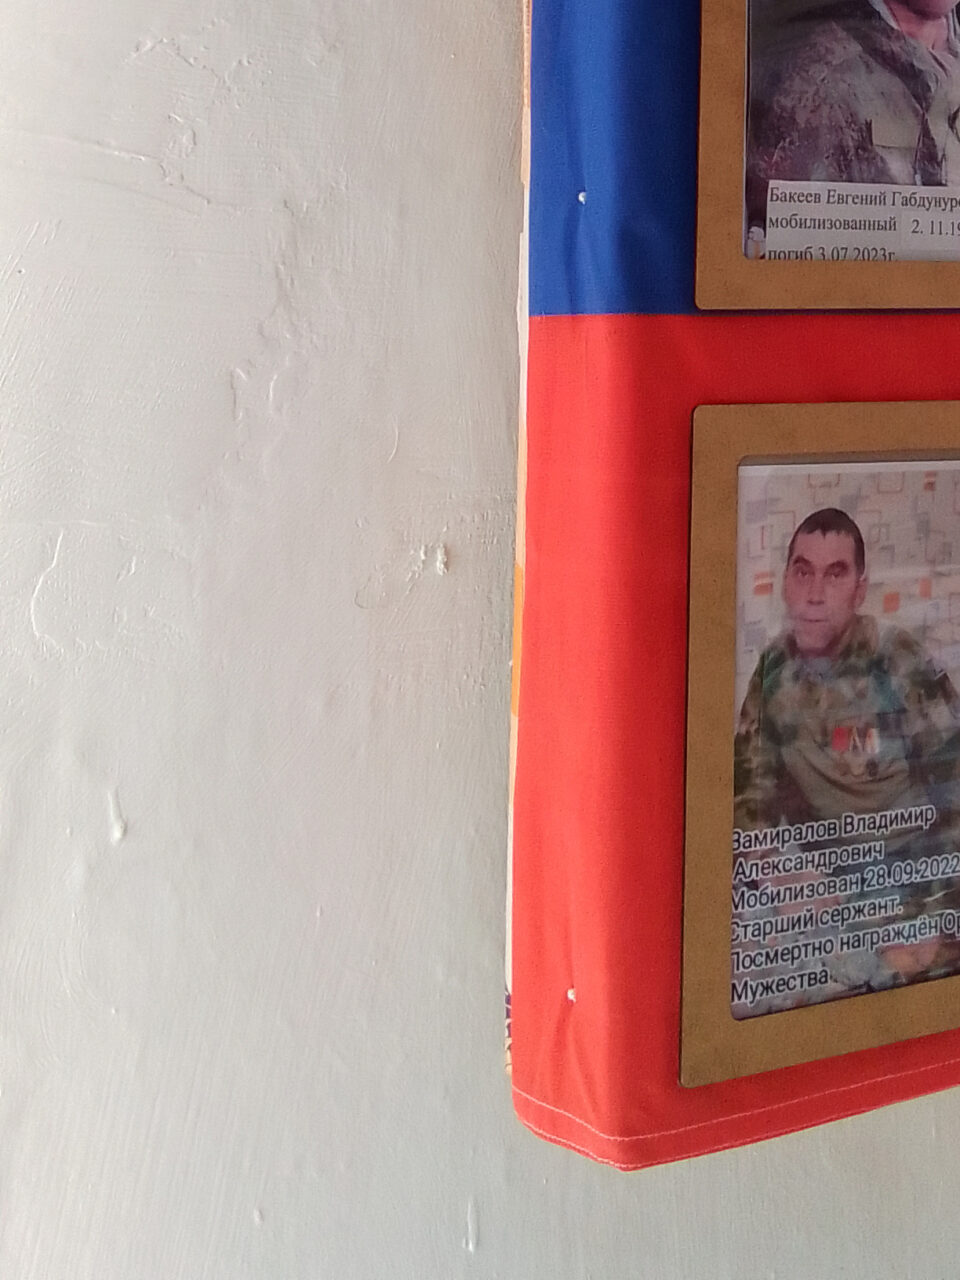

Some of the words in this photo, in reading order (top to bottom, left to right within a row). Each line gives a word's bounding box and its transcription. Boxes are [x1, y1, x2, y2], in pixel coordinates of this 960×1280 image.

[769, 187, 822, 204] Бакеев
[826, 189, 887, 206] Евгений
[768, 213, 897, 232] мобилизованный
[767, 247, 813, 260] погиб
[818, 246, 898, 261] 3072023г.
[732, 821, 838, 853] Замиралов
[842, 805, 936, 835] Владимир
[733, 841, 884, 881] Александрович
[732, 874, 860, 911] Мобилизован
[862, 853, 960, 887] 28.09.2022
[732, 908, 814, 942] Старший
[816, 896, 903, 927] сержант.
[840, 915, 938, 950] награждён
[732, 968, 829, 1005] Мужества
